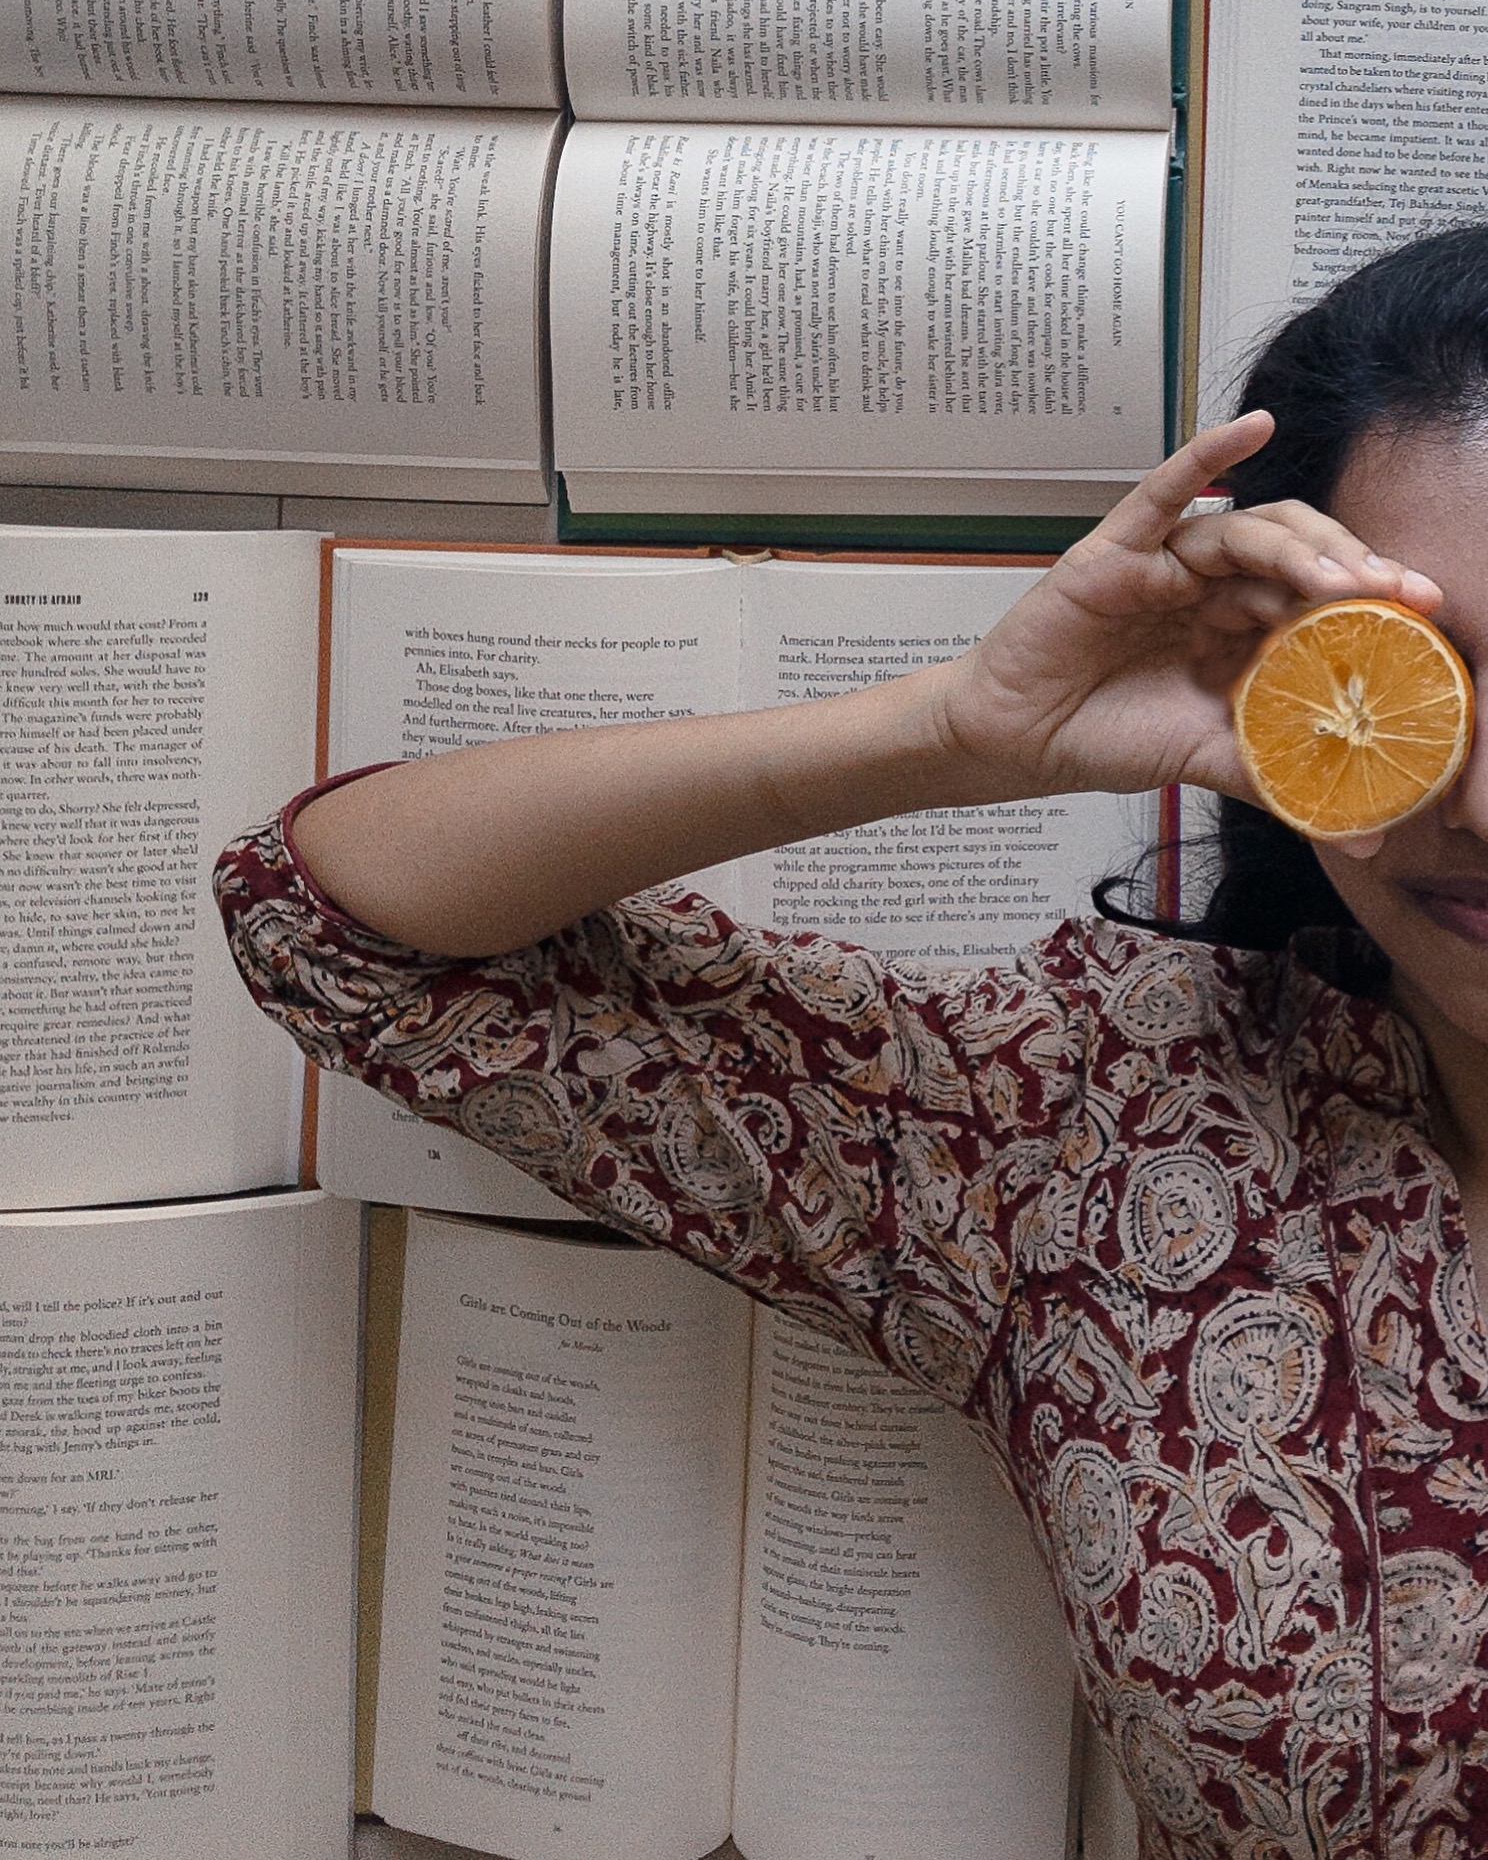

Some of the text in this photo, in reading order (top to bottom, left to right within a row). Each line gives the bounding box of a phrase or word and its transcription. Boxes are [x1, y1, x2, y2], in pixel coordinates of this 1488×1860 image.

[693, 149, 718, 344] She wants him to come to her himself.
[1111, 199, 1126, 347] YOU CAN’T GO HOME AGAIN
[4, 594, 82, 606] SHORTY IS AFRAID
[415, 661, 519, 683] Ah, Elisabeth says.
[458, 1292, 672, 1333] Girls are Coming Out of the Woods
[116, 1380, 222, 1404] my biker boots the
